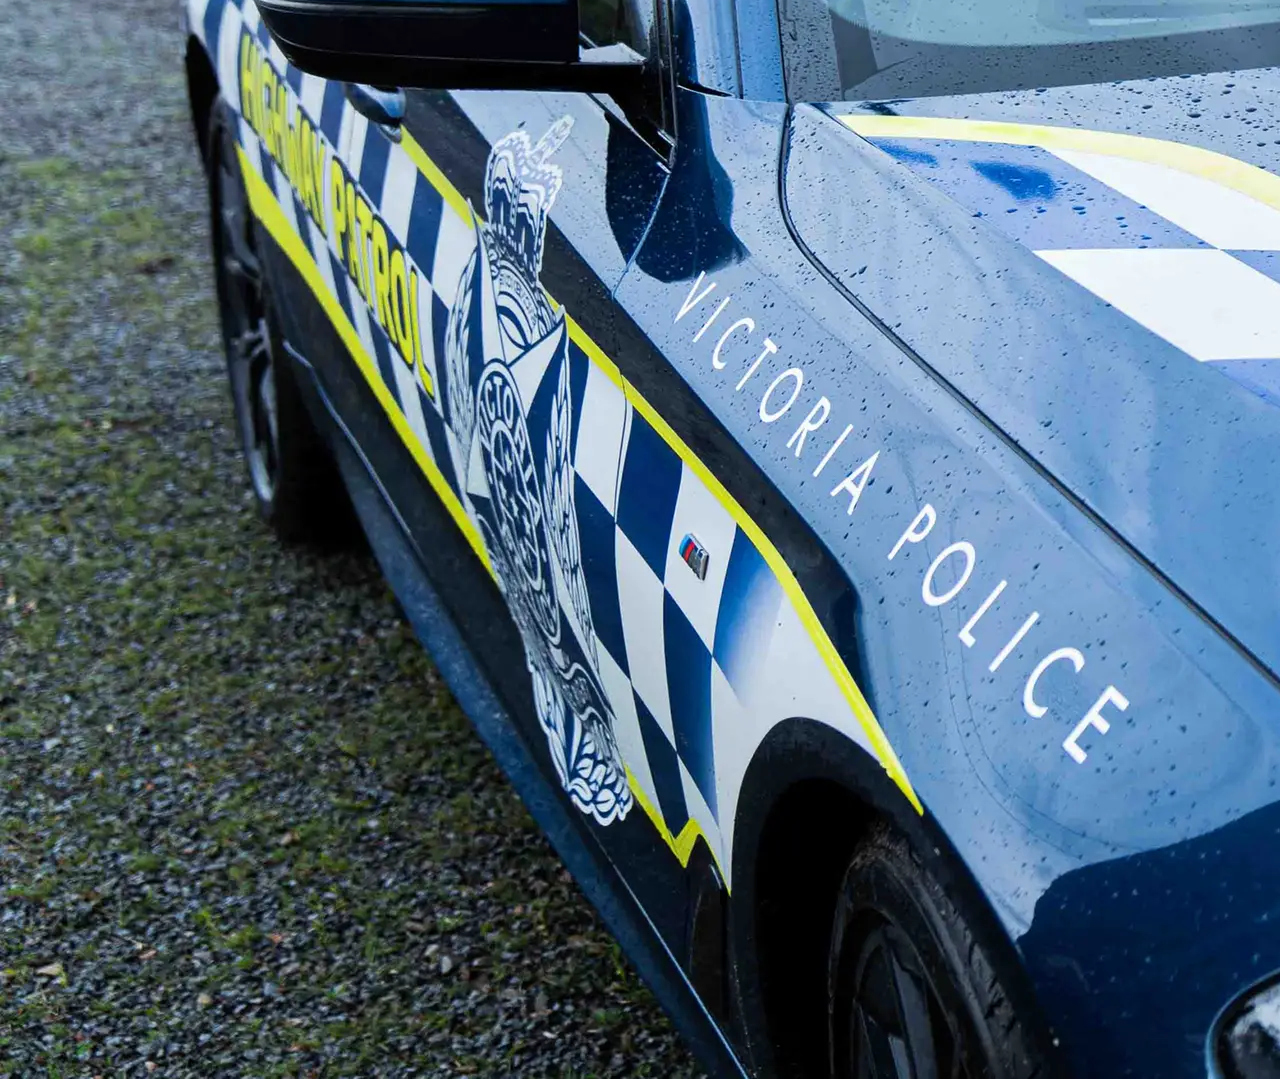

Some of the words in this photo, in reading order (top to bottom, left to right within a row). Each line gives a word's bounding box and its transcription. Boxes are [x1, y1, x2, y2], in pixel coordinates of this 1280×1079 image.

[240, 33, 326, 234] HIGHWAY
[331, 156, 434, 397] PATROL
[674, 270, 880, 515] VICTORIA
[887, 503, 1130, 765] POLICE
